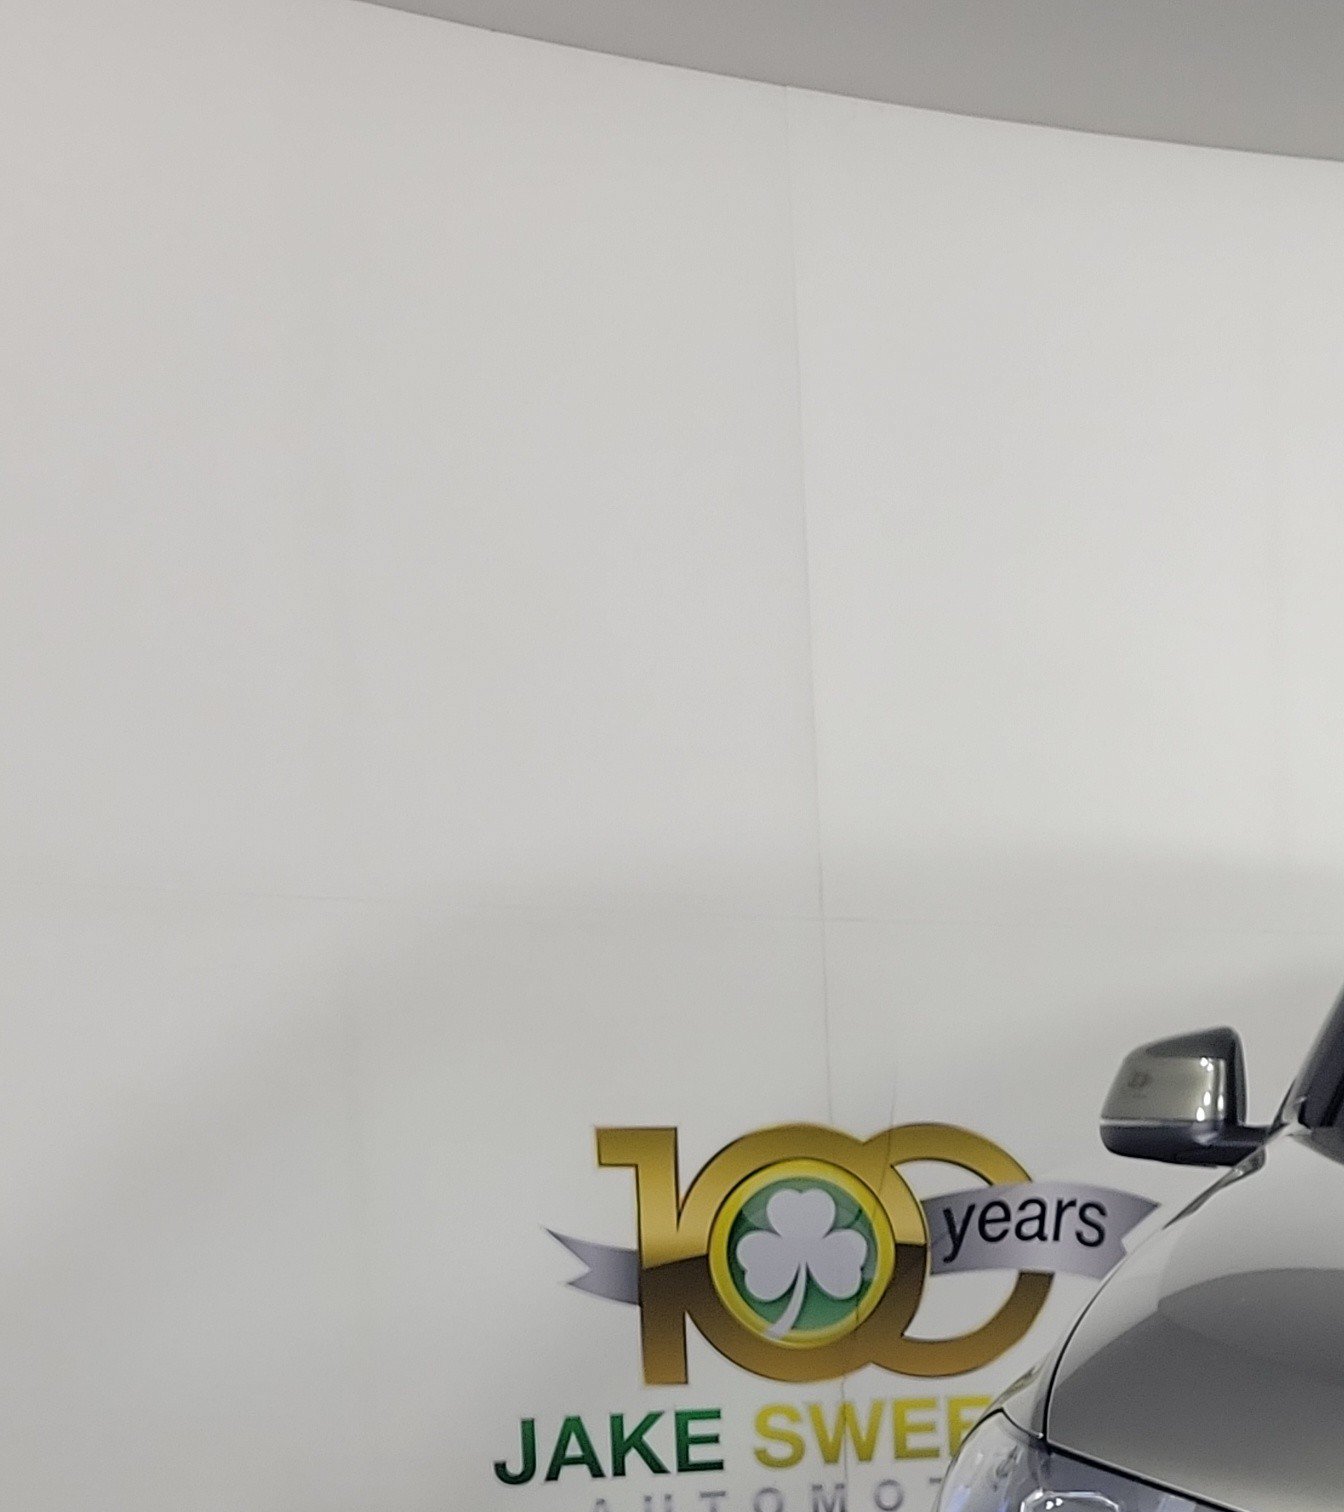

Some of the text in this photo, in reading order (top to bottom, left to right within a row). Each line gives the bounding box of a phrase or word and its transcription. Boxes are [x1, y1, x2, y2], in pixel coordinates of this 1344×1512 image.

[595, 1122, 1107, 1385] 100 years
[494, 1396, 993, 1485] JAKE SWEE
